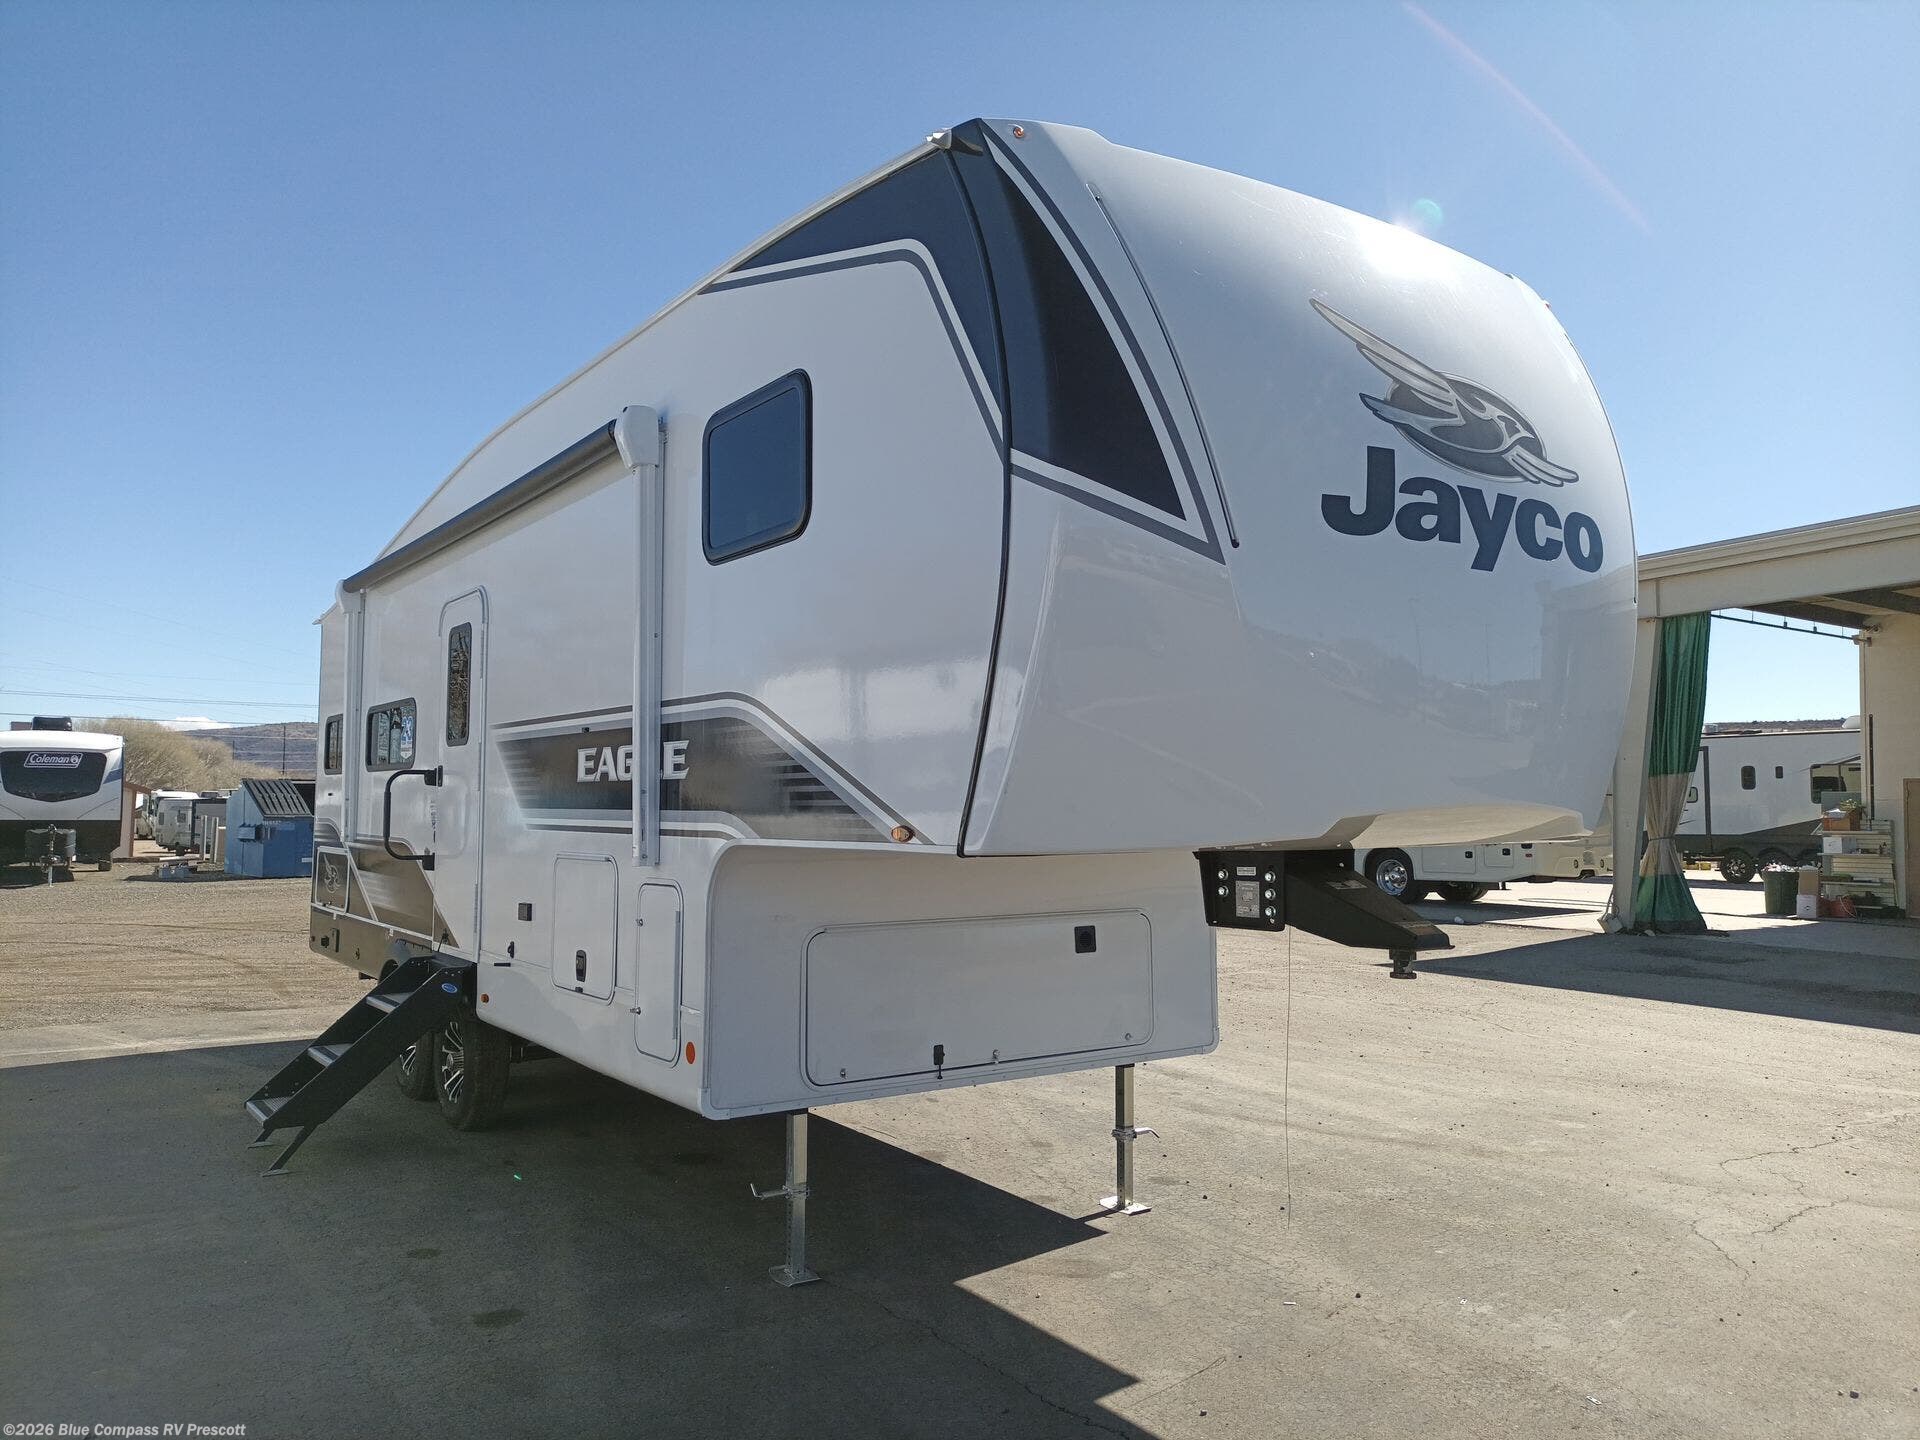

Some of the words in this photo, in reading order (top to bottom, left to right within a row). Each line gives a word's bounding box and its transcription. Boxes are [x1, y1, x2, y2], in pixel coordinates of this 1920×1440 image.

[1321, 445, 1604, 573] Jayco
[30, 753, 70, 763] Coleman
[577, 740, 690, 782] EAGE
